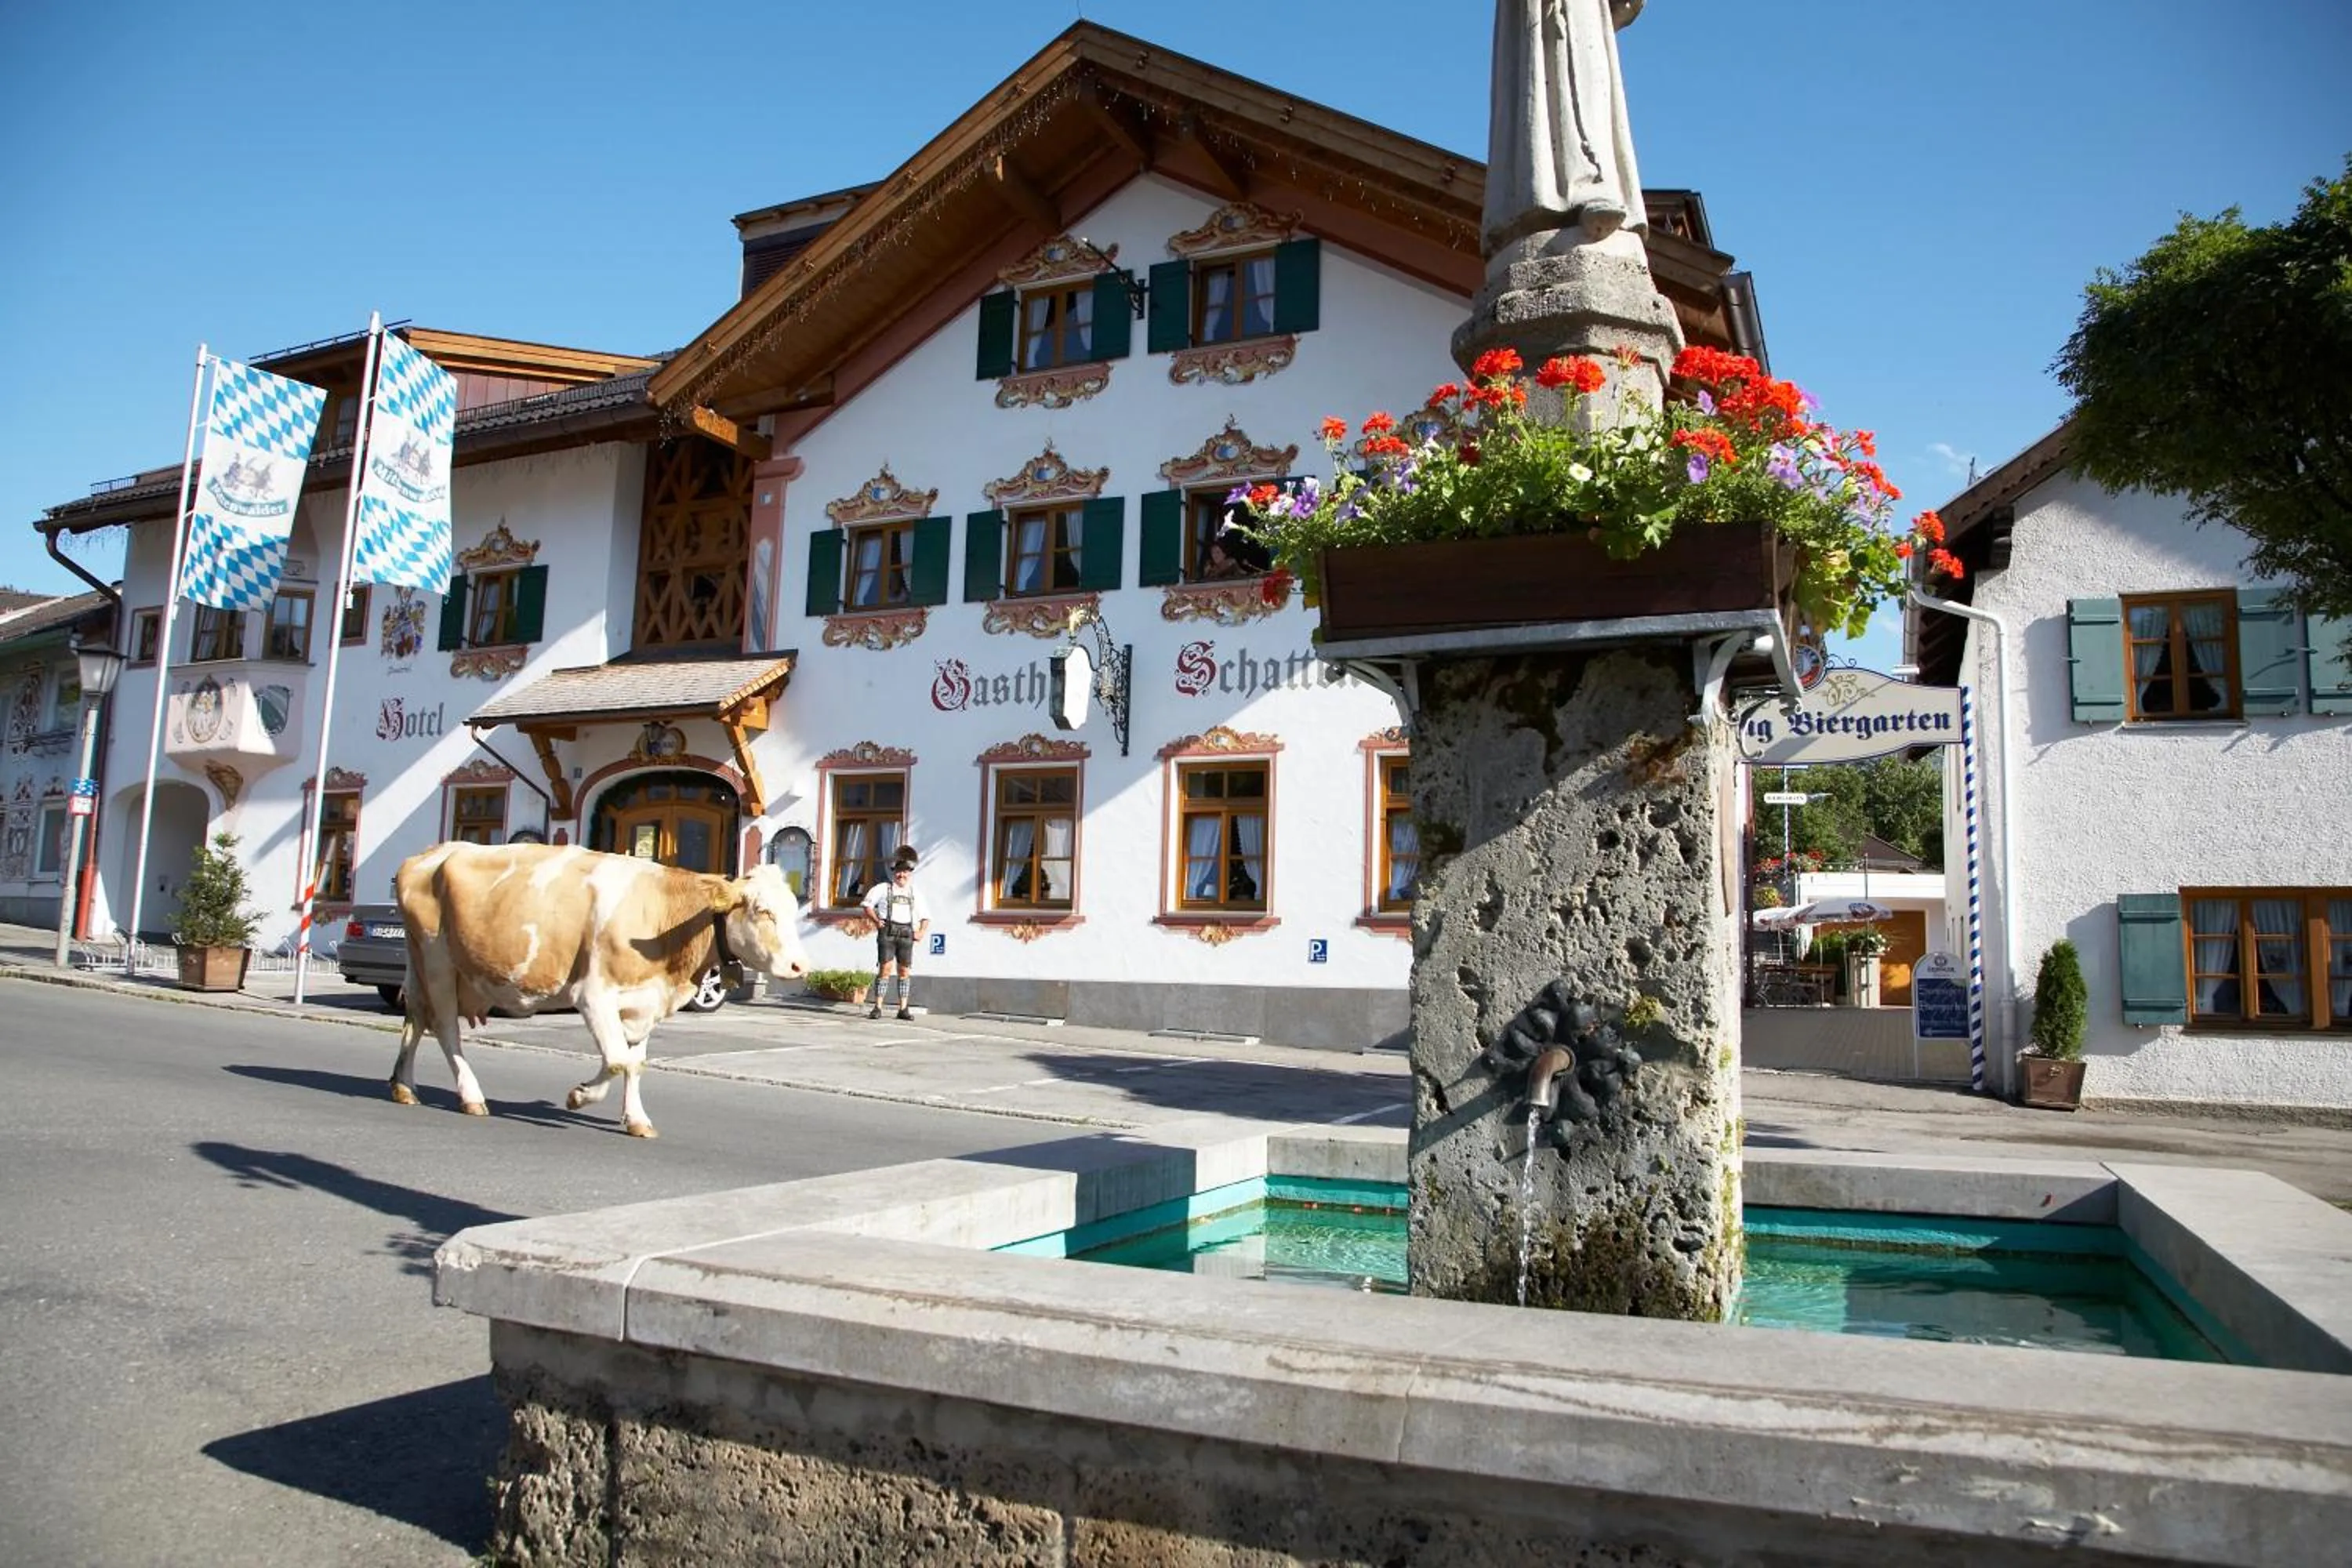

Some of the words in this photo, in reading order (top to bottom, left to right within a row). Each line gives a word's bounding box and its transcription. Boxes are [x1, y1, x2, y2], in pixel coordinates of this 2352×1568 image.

[931, 658, 1047, 711] Gasth
[376, 697, 445, 741] Hotel
[1787, 708, 1951, 741] Biergarten
